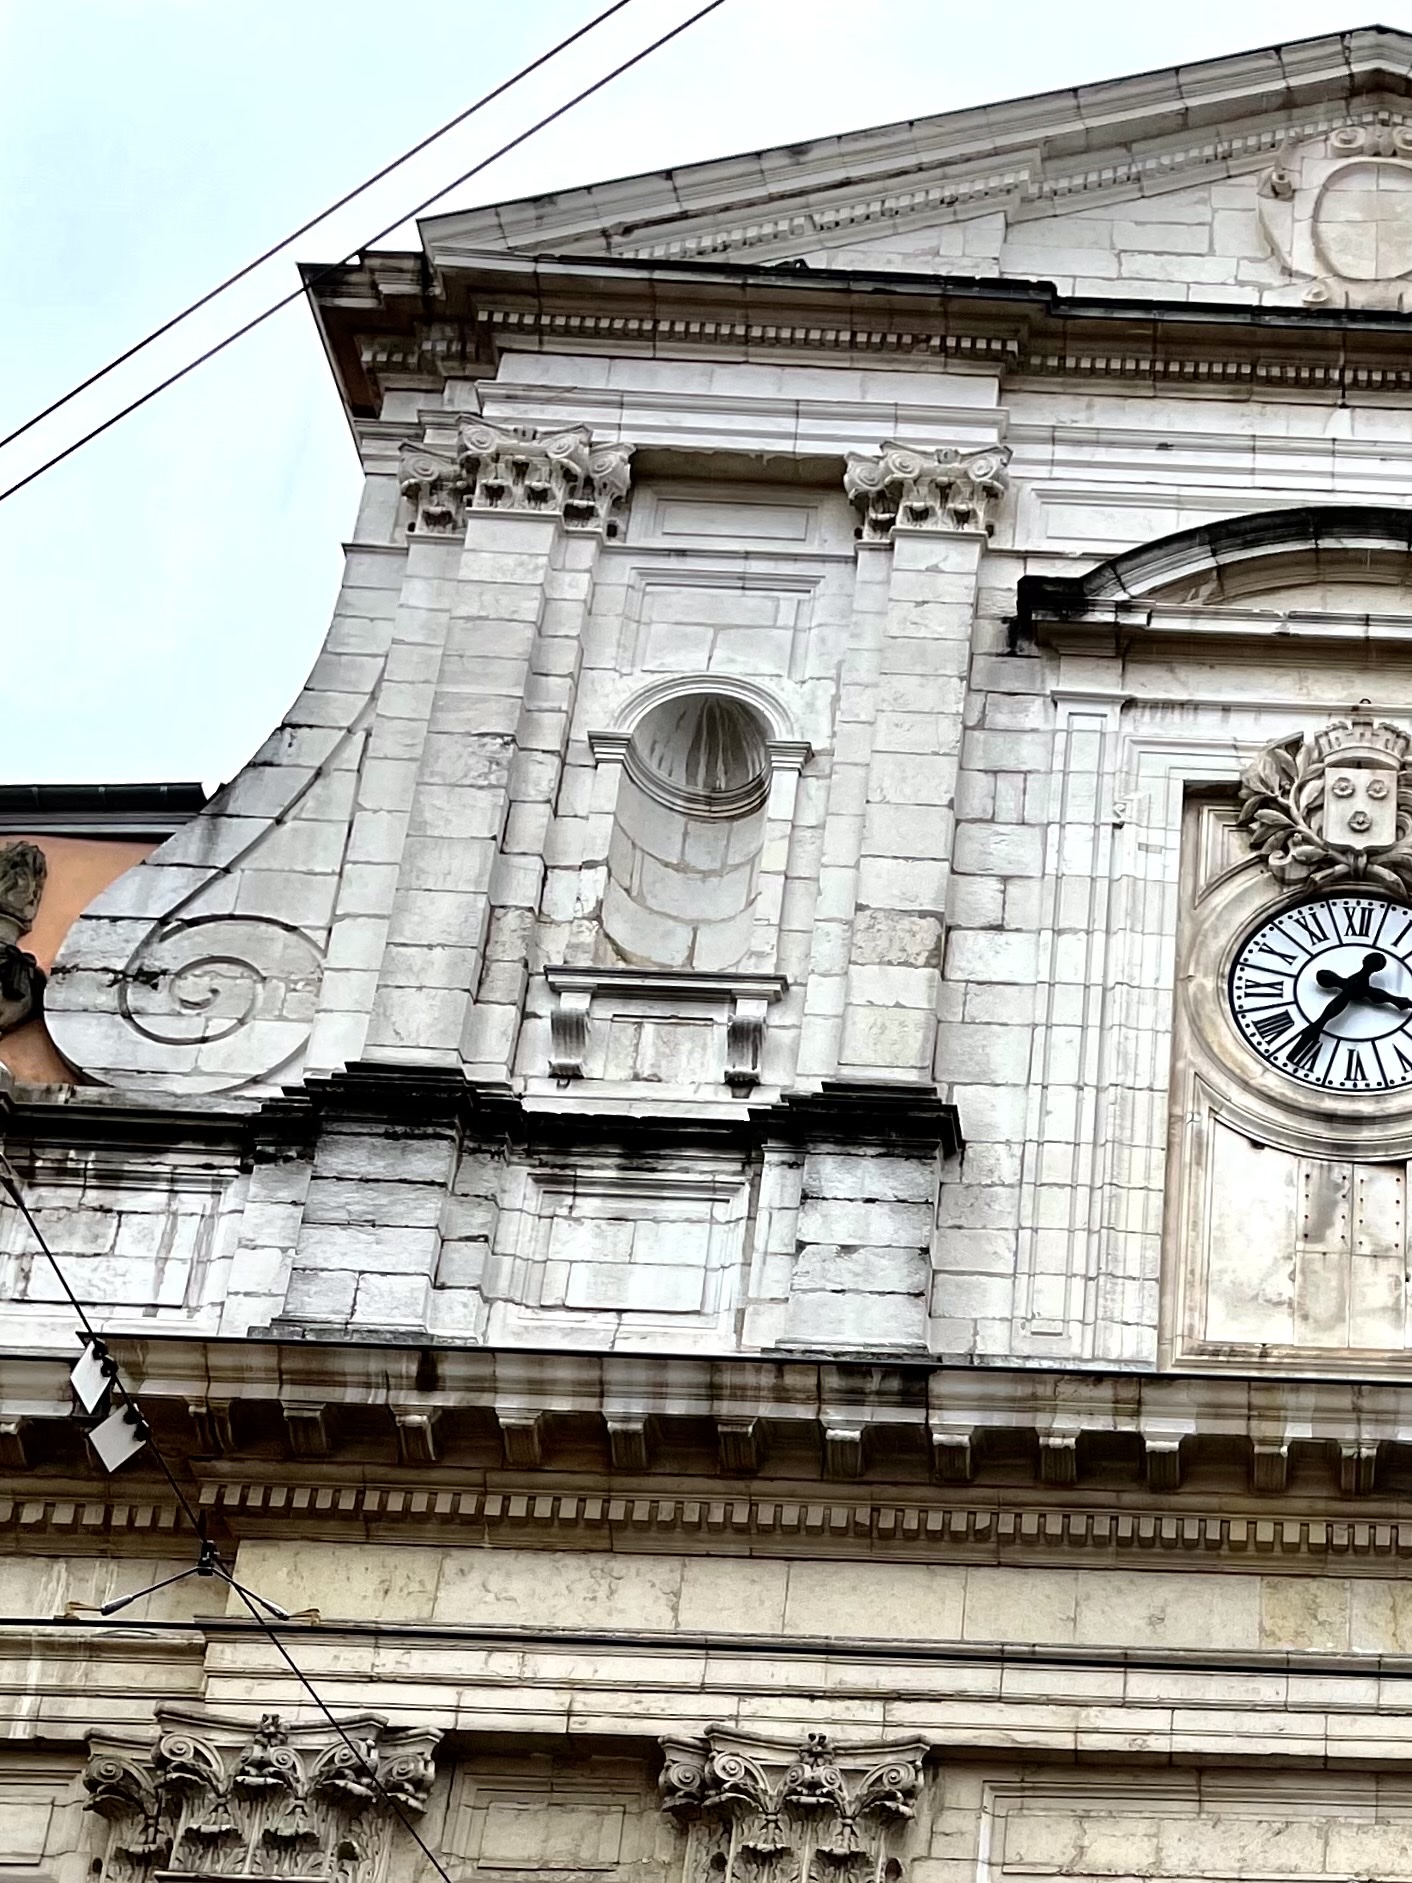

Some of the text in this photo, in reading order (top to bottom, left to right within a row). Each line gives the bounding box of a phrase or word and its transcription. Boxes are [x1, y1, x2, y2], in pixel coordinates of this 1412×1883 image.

[1296, 911, 1330, 946] XI
[1344, 906, 1375, 937] XII
[1258, 942, 1298, 965] X
[1244, 979, 1284, 998] IX
[1251, 1010, 1295, 1046] VIII
[1345, 1049, 1368, 1081] VI
